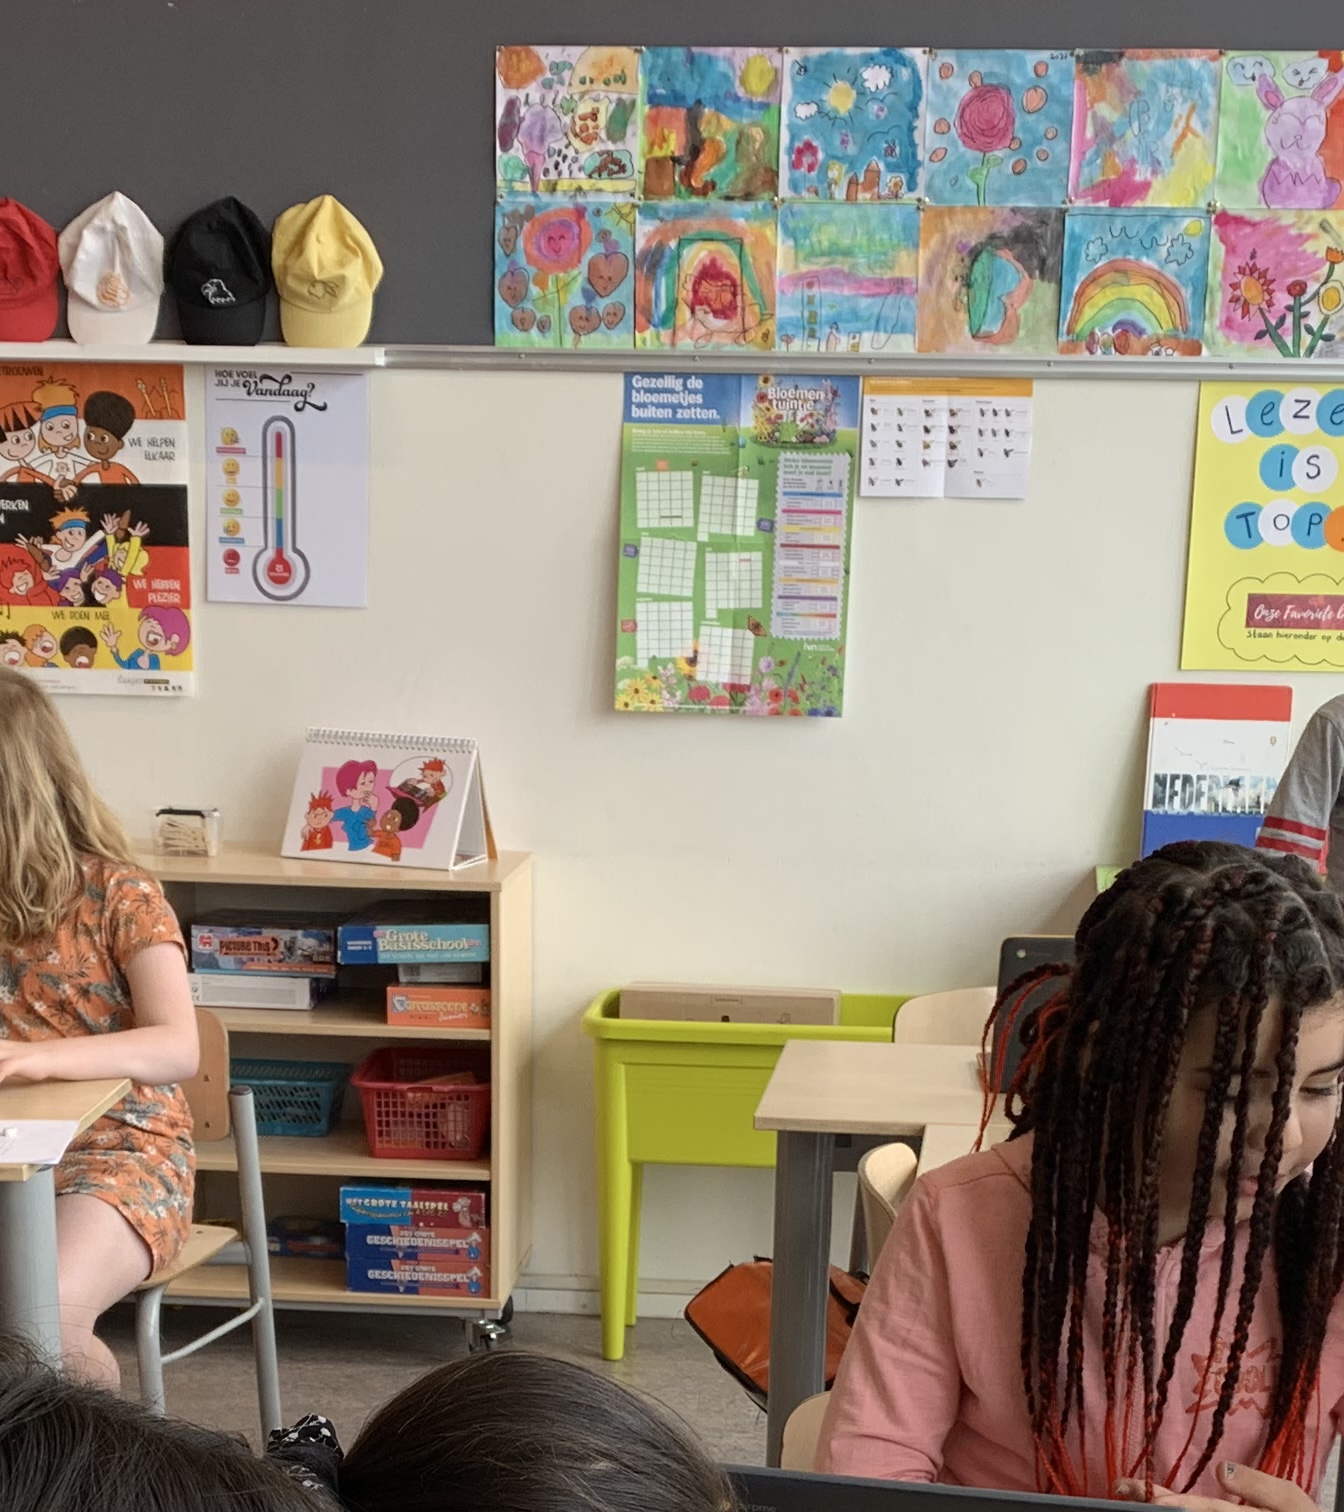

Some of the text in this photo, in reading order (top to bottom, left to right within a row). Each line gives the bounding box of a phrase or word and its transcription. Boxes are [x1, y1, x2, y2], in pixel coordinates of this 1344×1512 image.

[214, 369, 234, 379] HOE
[214, 379, 241, 388] JIJ JE
[632, 375, 703, 391] Gezellig de
[631, 390, 703, 405] bloemetjes
[631, 405, 720, 419] buiten zetten.
[128, 437, 176, 448] WE HELPEN
[144, 451, 176, 461] ELKAAR
[1277, 453, 1321, 480] is
[132, 579, 147, 590] WE
[52, 610, 110, 621] WE DOEN MEE
[1254, 603, 1281, 622] Onze
[1283, 604, 1334, 621] Favoriete
[1276, 630, 1318, 641] hieronder
[1321, 634, 1332, 642] op
[386, 928, 428, 942] Grote
[219, 940, 252, 952] PICTURE
[377, 937, 469, 952] Basisschool
[366, 1235, 469, 1248] GESCHIEDENISSPEL
[367, 1269, 470, 1282] GESCHIEDENISSPEL
